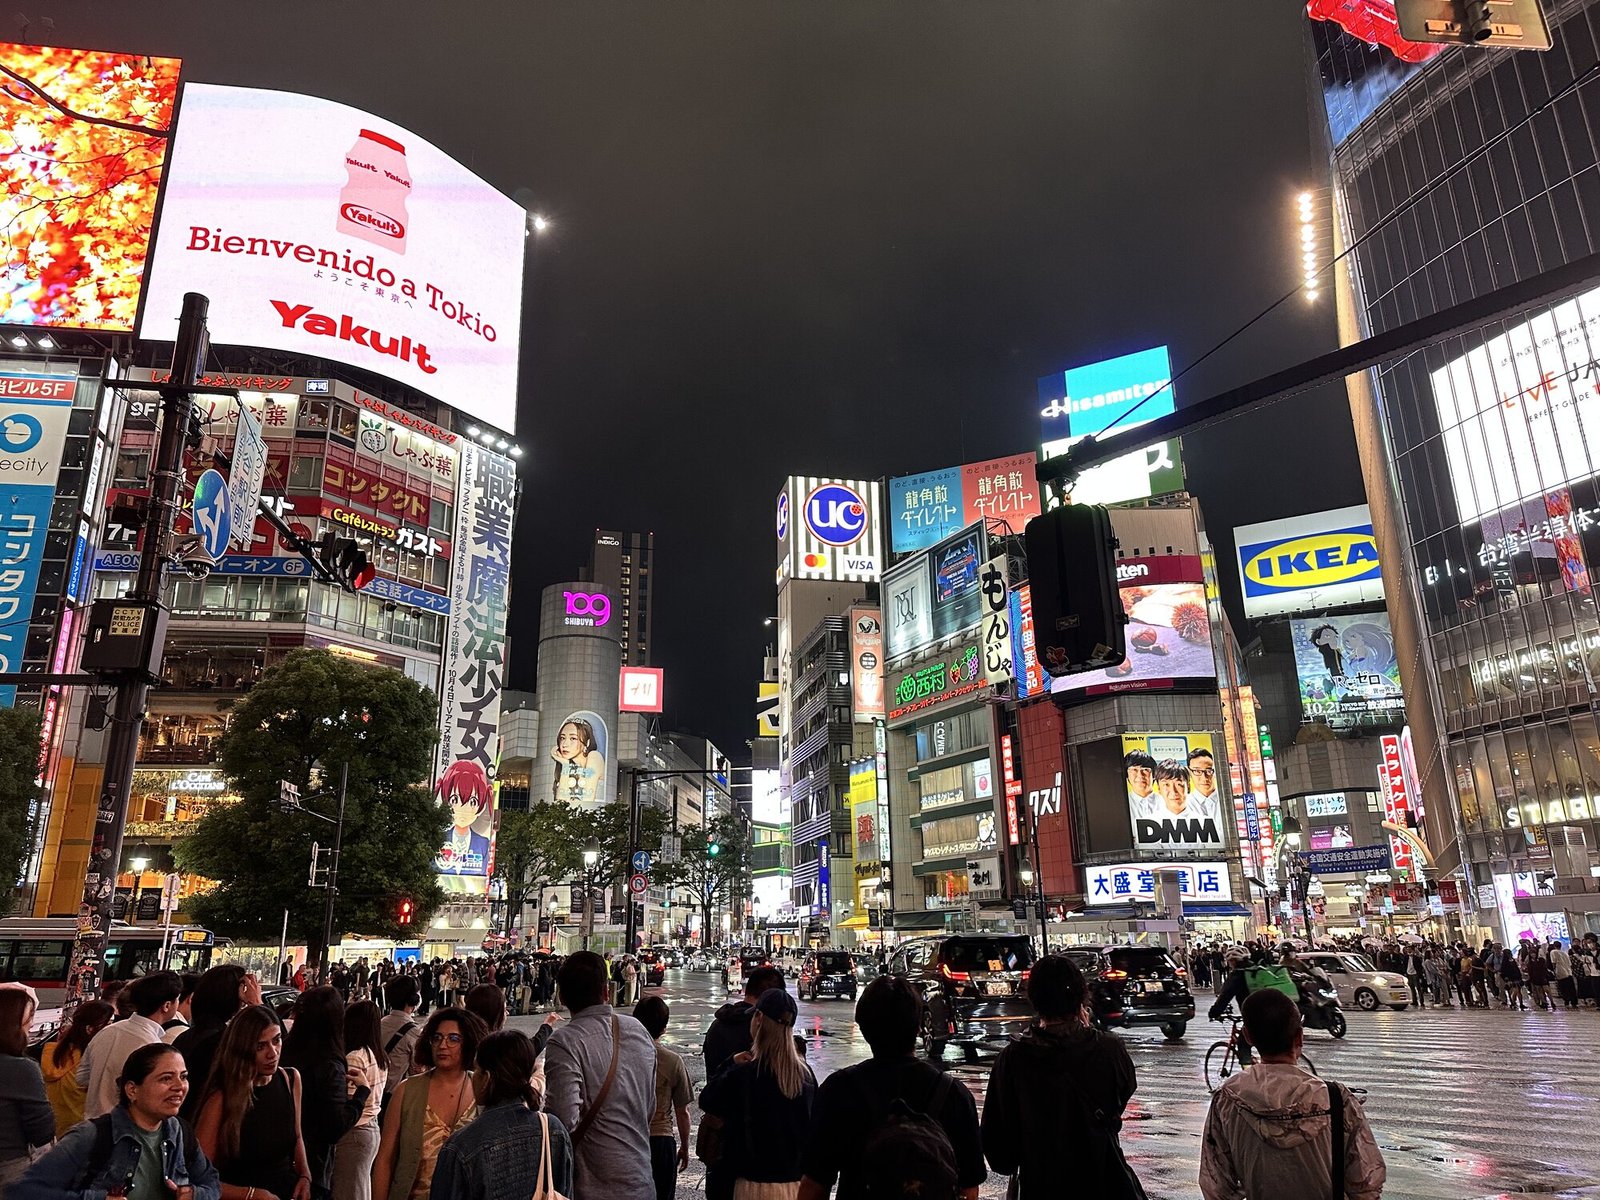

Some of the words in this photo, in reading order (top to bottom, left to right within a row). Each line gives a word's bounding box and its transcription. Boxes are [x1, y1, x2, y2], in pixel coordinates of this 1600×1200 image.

[383, 170, 411, 188] Yakult
[349, 206, 400, 236] Yakult
[186, 226, 395, 288] Bienvenido
[400, 279, 417, 300] a
[425, 283, 497, 342] Tokio
[313, 270, 413, 309] ようこそ東京へ
[269, 299, 437, 375] Yakult
[151, 370, 293, 390] しゃぶバイキング
[308, 381, 328, 392] 寿司
[1504, 370, 1558, 409] LVE
[129, 402, 157, 418] 9F
[1040, 378, 1171, 418] Hisamitsu
[1529, 404, 1560, 423] ERFECT
[1562, 393, 1590, 408] GUDE
[353, 390, 458, 443] しゃぶしゃぶバイキング
[393, 435, 452, 476] しゃぶ葉
[966, 456, 1033, 475] のど、直接、うるおう
[324, 462, 428, 519] コンタクト
[894, 472, 957, 489] のど、直接、うるおう
[978, 470, 1023, 496] 龍角散
[905, 484, 948, 510] 龍角散
[973, 491, 1033, 516] ダイレクト
[811, 498, 862, 530] UC
[900, 504, 957, 529] ダイレクト
[397, 526, 443, 556] ガスト
[103, 554, 142, 568] AEON
[285, 561, 303, 573] 6F
[847, 559, 874, 571] VISA
[1256, 541, 1380, 579] IKEA
[362, 580, 450, 611] 英会話イーオン
[563, 591, 611, 627] 109
[564, 617, 594, 627] SHIBUYA
[981, 562, 1013, 677] もんじゃ
[1498, 648, 1550, 673] SAE
[917, 670, 945, 698] 西村
[1109, 682, 1130, 691] Rakuten
[1131, 681, 1148, 689] Vision
[1385, 744, 1405, 802] カラオケ
[1029, 771, 1062, 817] クスリ
[1317, 795, 1345, 805] れいわ
[1309, 805, 1345, 815] クリニック
[1507, 796, 1600, 828] STAR
[1136, 818, 1220, 844] DMM
[1309, 848, 1387, 863] 全国交通安全運動実施中
